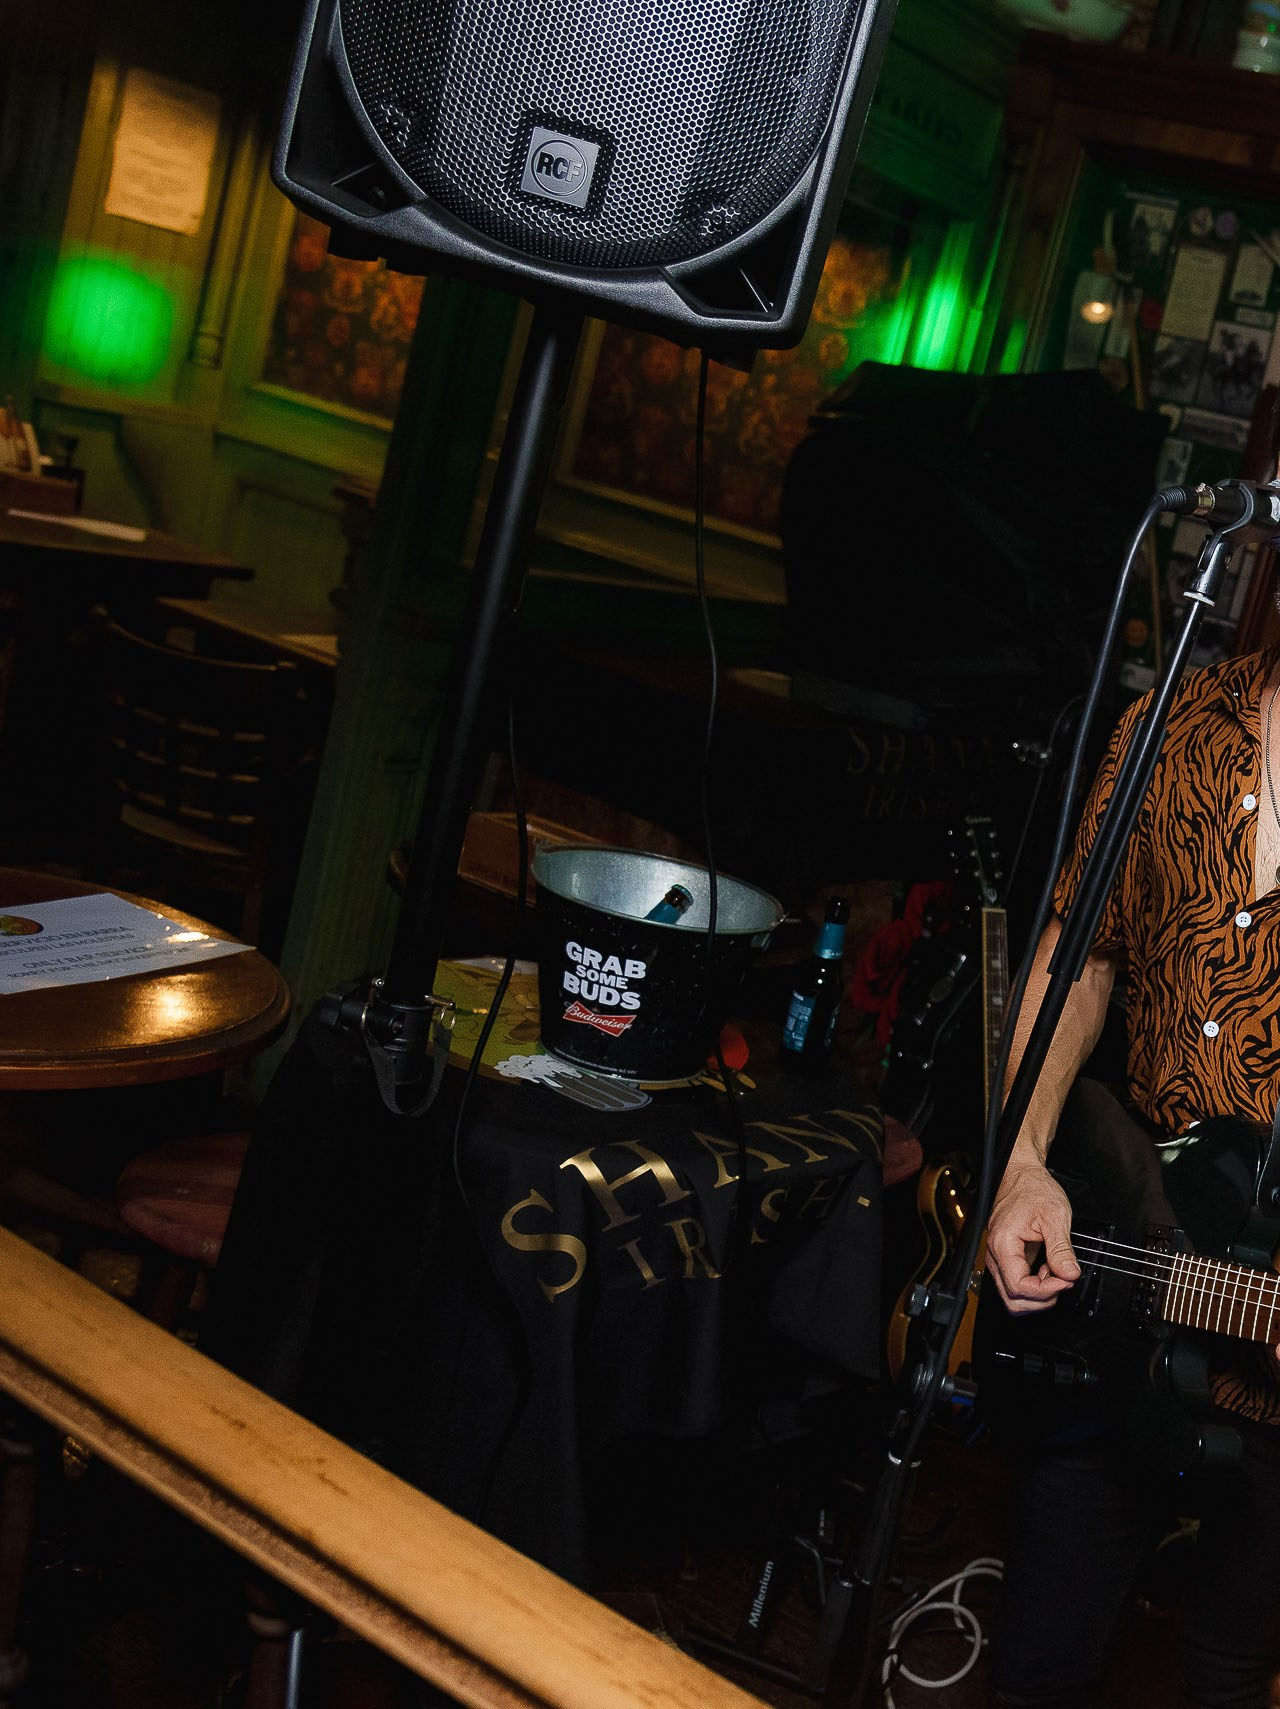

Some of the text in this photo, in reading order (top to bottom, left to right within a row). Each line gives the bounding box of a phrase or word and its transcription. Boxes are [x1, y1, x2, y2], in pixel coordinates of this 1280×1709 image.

[536, 150, 583, 183] RCF
[22, 958, 65, 969] ONLY
[565, 941, 647, 979] GRAB
[563, 970, 641, 1010] BUDS
[575, 964, 629, 990] SOME
[564, 1001, 632, 1031] Budweiser
[748, 1560, 775, 1628] Millenium
